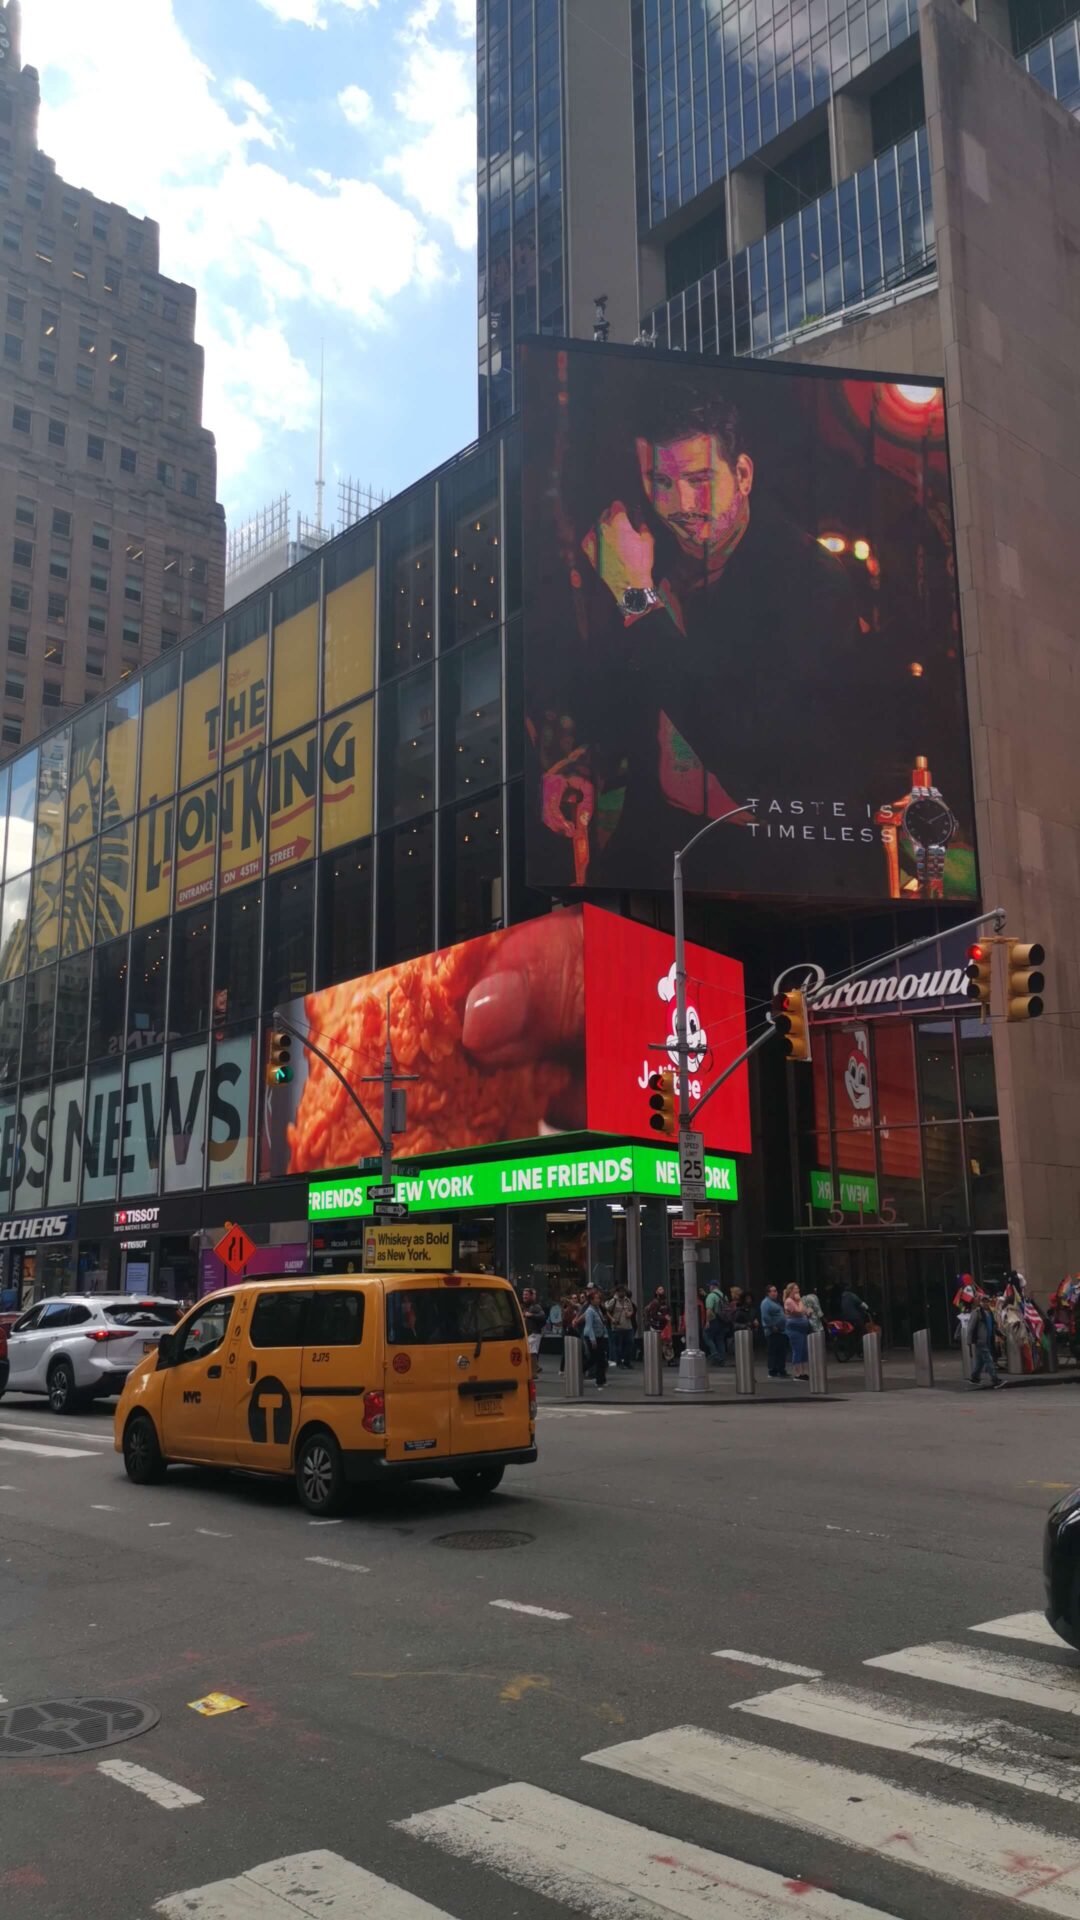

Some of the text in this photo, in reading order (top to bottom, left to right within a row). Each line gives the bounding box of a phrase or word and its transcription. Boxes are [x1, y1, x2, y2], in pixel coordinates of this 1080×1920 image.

[204, 678, 265, 751] THE
[146, 721, 355, 892] LION KING
[747, 798, 893, 818] TASTE IS
[747, 823, 894, 843] TIMELESS
[179, 846, 295, 902] ENTRANCE ON 45TH STREET
[63, 1062, 241, 1182] NEWS
[427, 1175, 474, 1199] YORK
[501, 1168, 542, 1192] LINE
[547, 1157, 632, 1188] FRIENDS
[684, 1160, 702, 1179] 25
[705, 1167, 731, 1190] ORK
[127, 1208, 160, 1223] TISSOT
[805, 1198, 896, 1227] 1515
[0, 1214, 68, 1242] ECHERS
[127, 1240, 147, 1249] TISSOT
[378, 1232, 449, 1247] Whiskey as Bold
[377, 1252, 386, 1261] as
[387, 1250, 405, 1261] New
[408, 1249, 431, 1261] York.
[312, 1352, 330, 1362] 2J75
[183, 1391, 201, 1404] NYC
